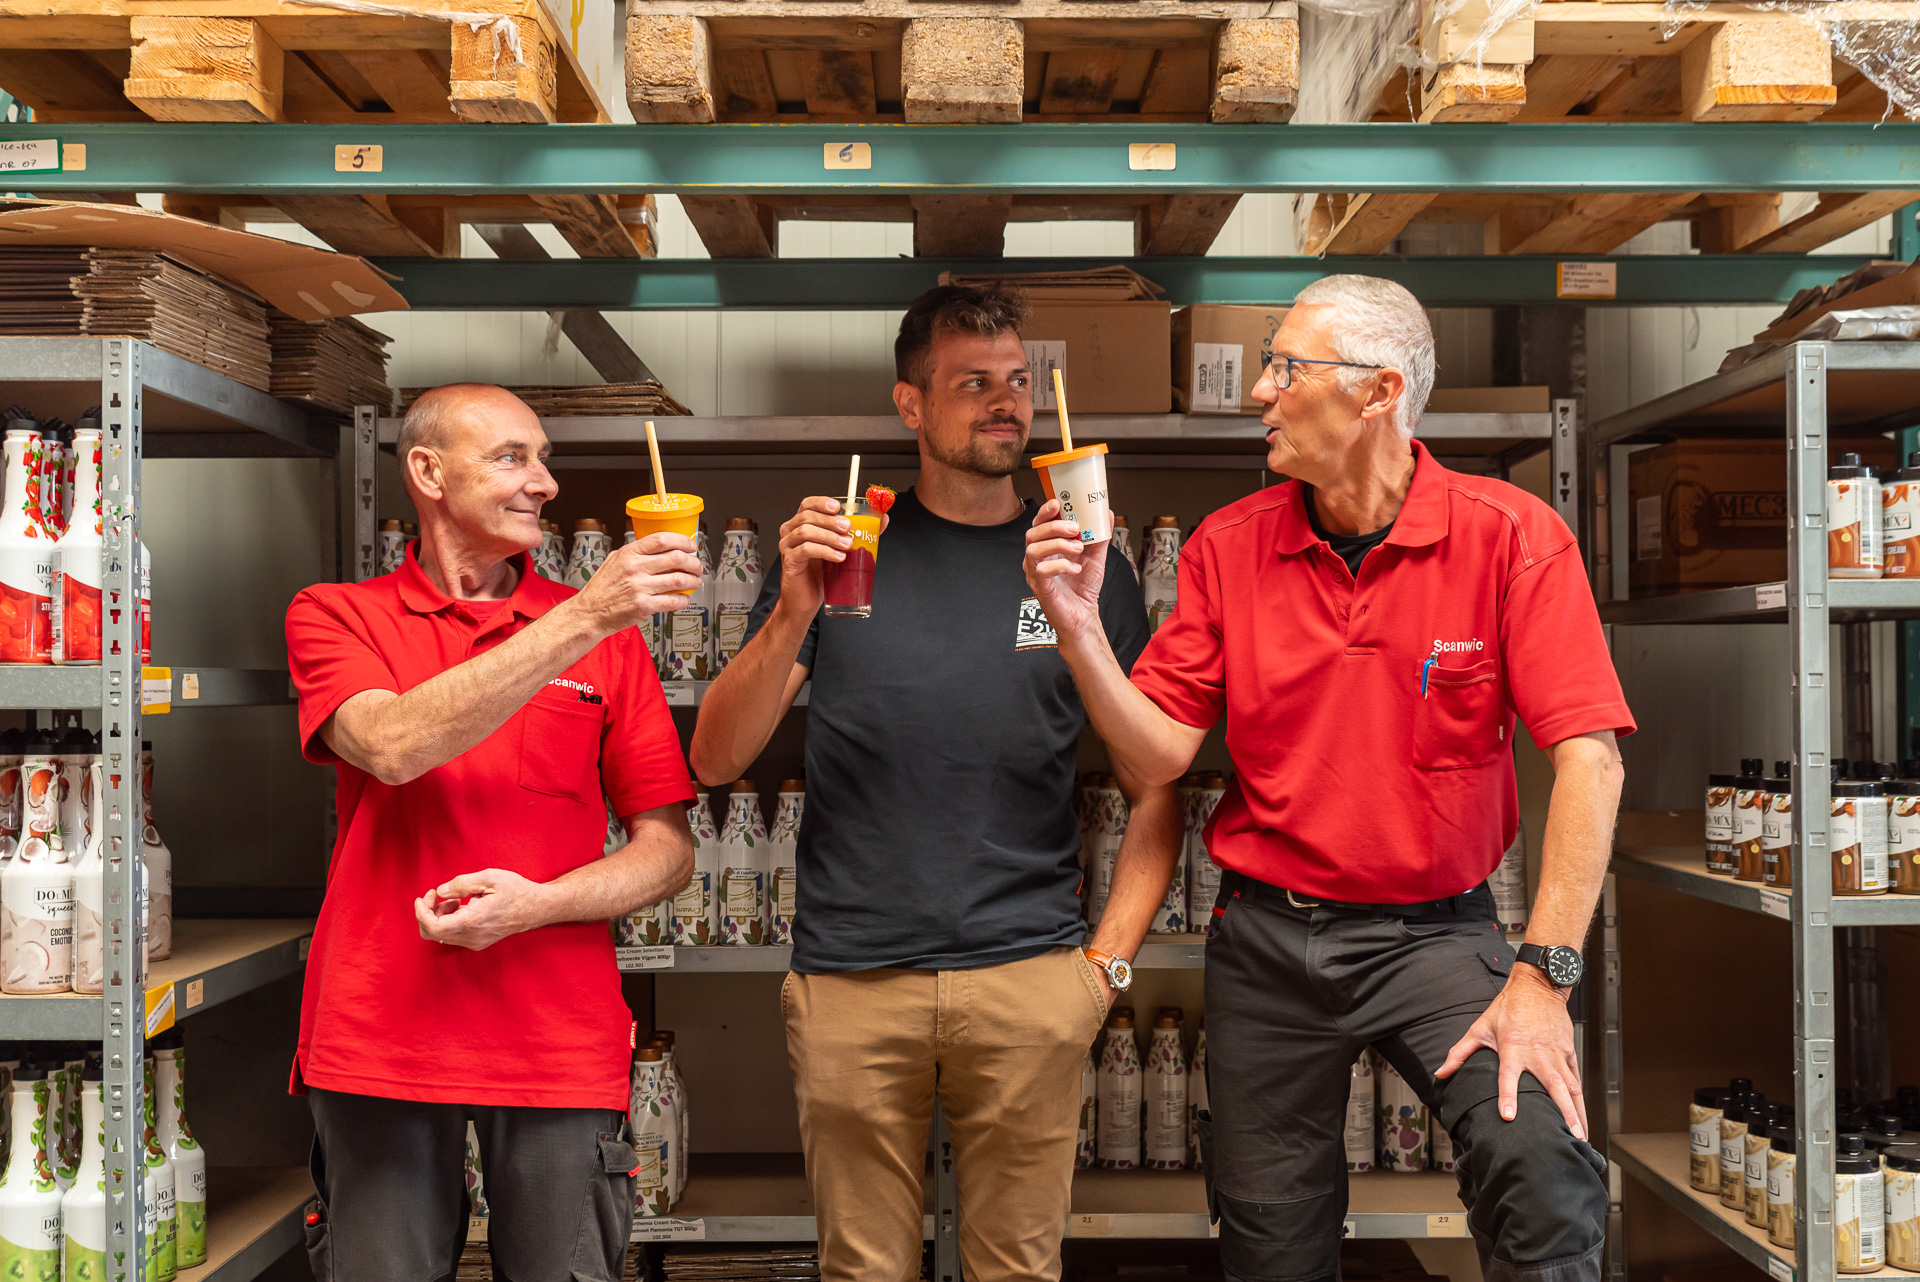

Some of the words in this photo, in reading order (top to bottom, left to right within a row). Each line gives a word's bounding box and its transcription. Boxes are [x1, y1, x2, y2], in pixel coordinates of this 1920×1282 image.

[352, 147, 371, 169] 5
[839, 143, 853, 163] 6
[1087, 489, 1108, 503] ISIN
[1718, 494, 1787, 517] MEC3
[674, 642, 701, 650] Cream
[1433, 638, 1484, 652] Scanwic
[675, 906, 701, 914] Cream
[728, 906, 755, 914] Cream
